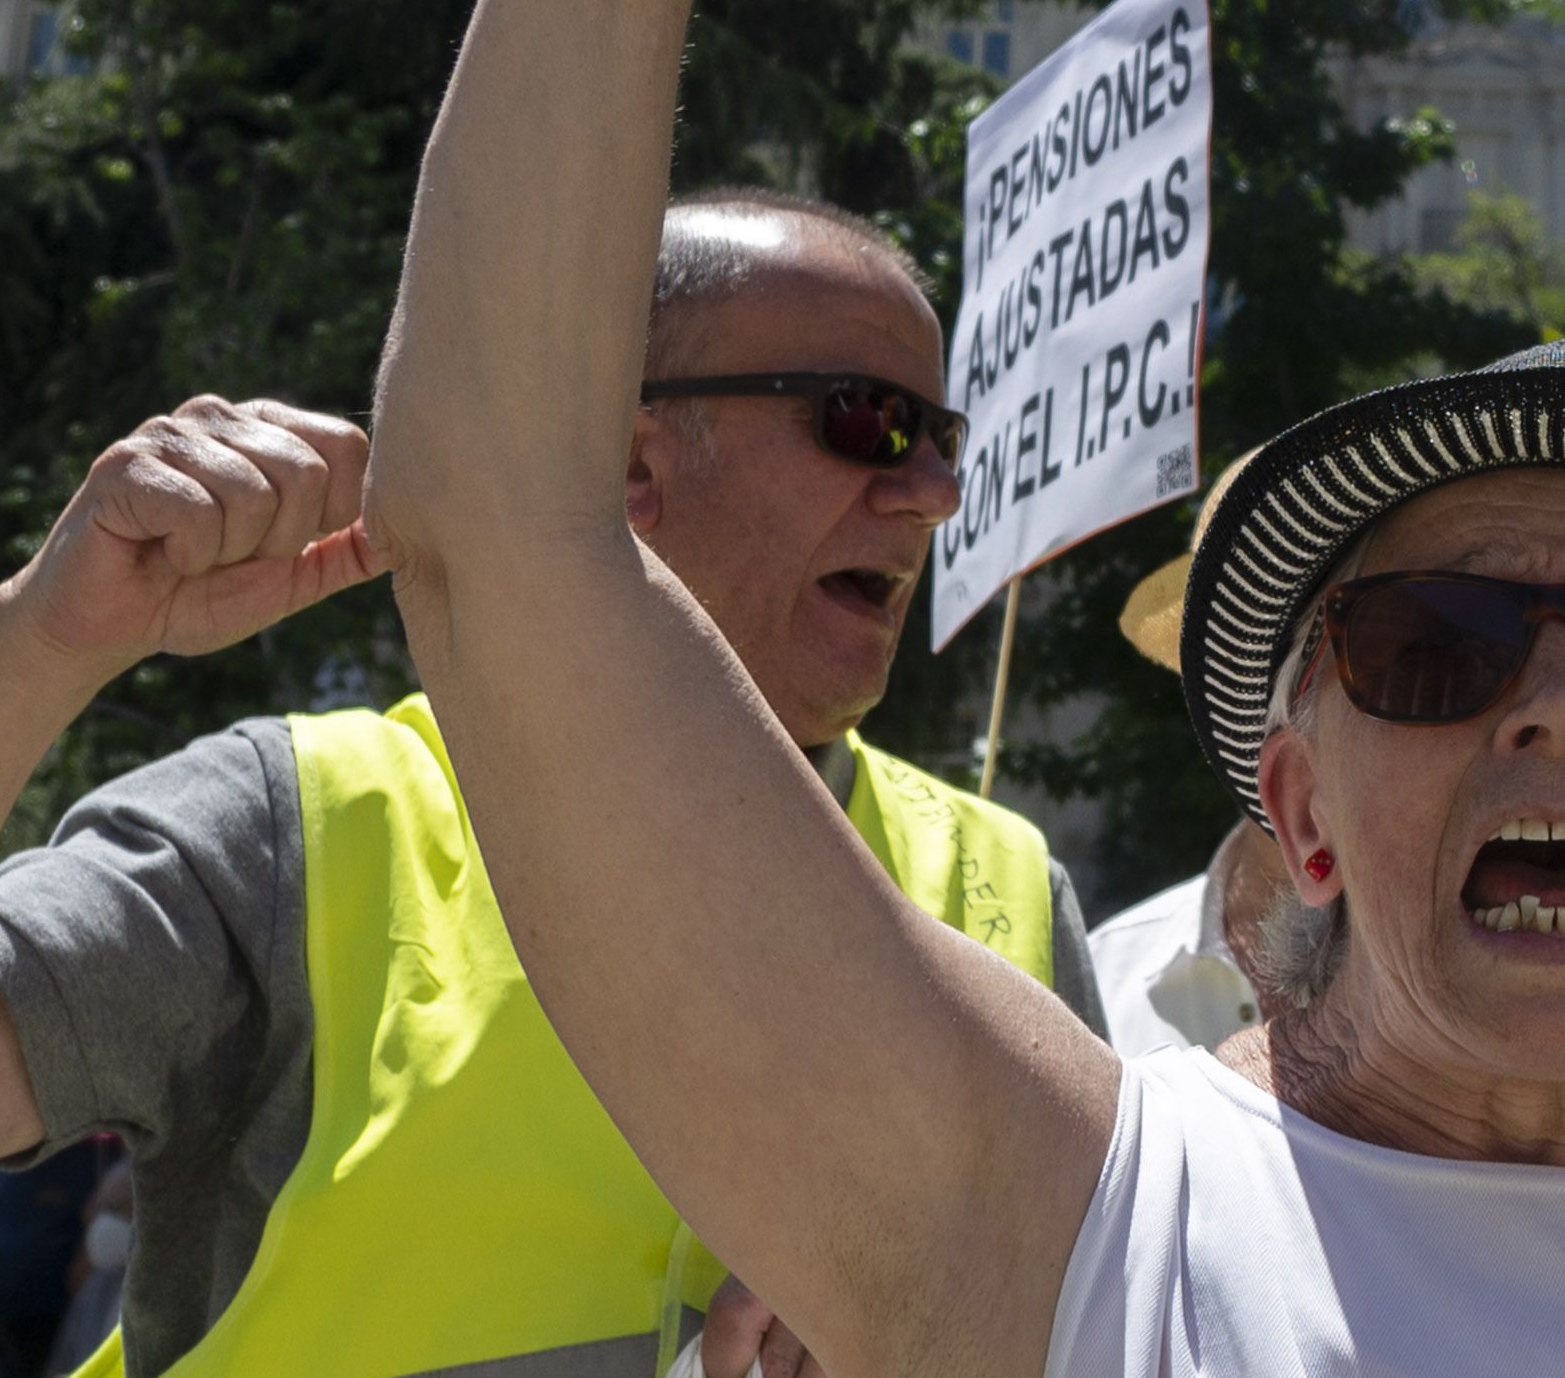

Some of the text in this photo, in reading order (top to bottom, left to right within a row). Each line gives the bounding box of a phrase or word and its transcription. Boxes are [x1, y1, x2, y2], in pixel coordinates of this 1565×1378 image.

[975, 6, 1193, 293] ¡PENSIONES
[964, 155, 1191, 413] AJUSTADAS
[1011, 385, 1063, 505] EL
